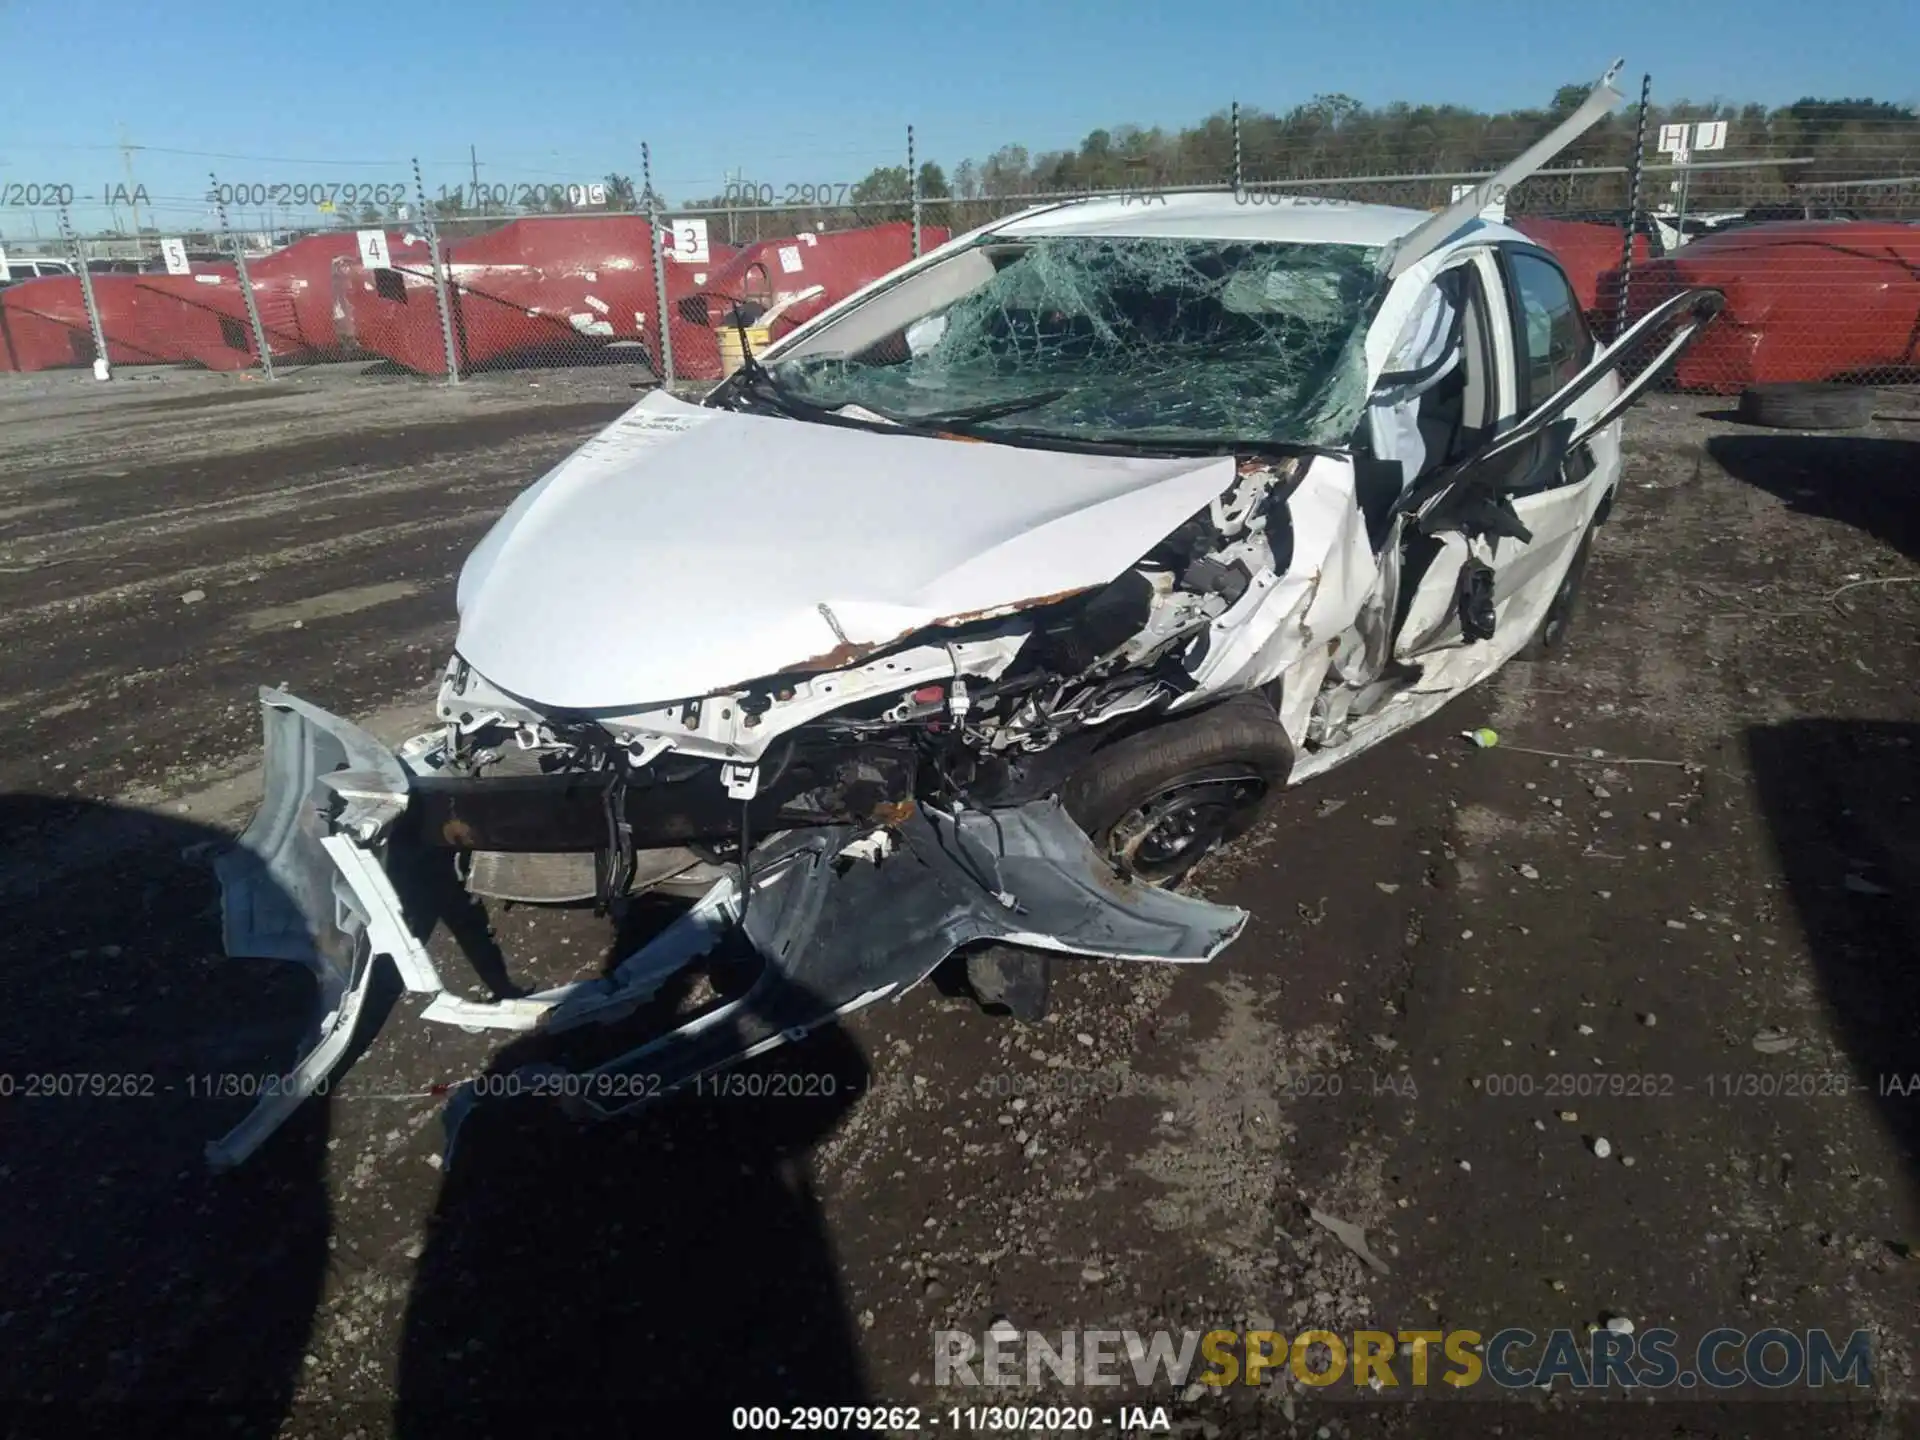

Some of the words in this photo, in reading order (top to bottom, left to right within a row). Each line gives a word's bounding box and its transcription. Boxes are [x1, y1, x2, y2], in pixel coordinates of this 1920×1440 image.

[1663, 126, 1684, 150] H
[1703, 123, 1718, 148] J
[369, 238, 380, 260] 4
[684, 228, 698, 254] 3
[169, 246, 181, 267] 5
